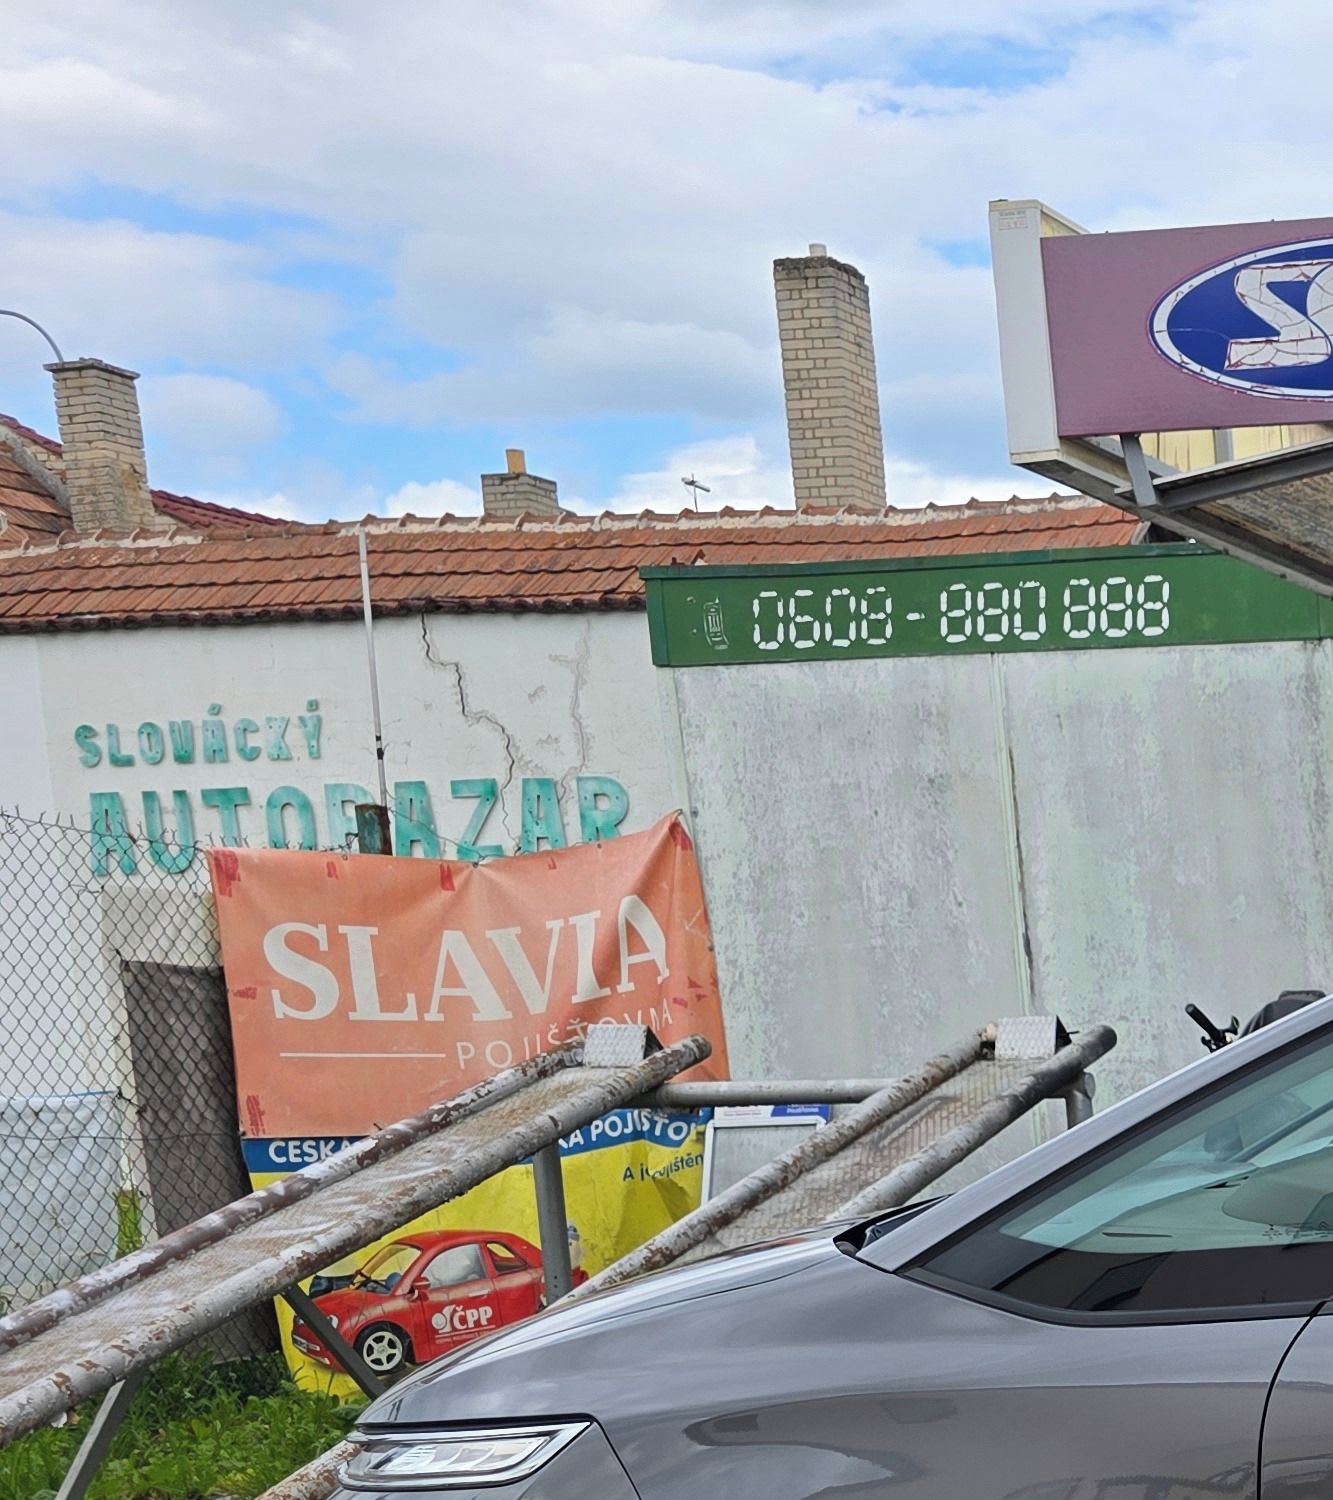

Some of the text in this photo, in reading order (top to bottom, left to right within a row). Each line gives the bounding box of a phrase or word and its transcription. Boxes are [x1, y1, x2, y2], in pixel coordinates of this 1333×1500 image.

[1063, 575, 1170, 638] 888
[74, 699, 322, 768] SLOVÁCKÝ
[262, 894, 671, 1022] SLAVIA
[622, 1166, 635, 1182] A
[452, 1305, 493, 1330] ČPP
